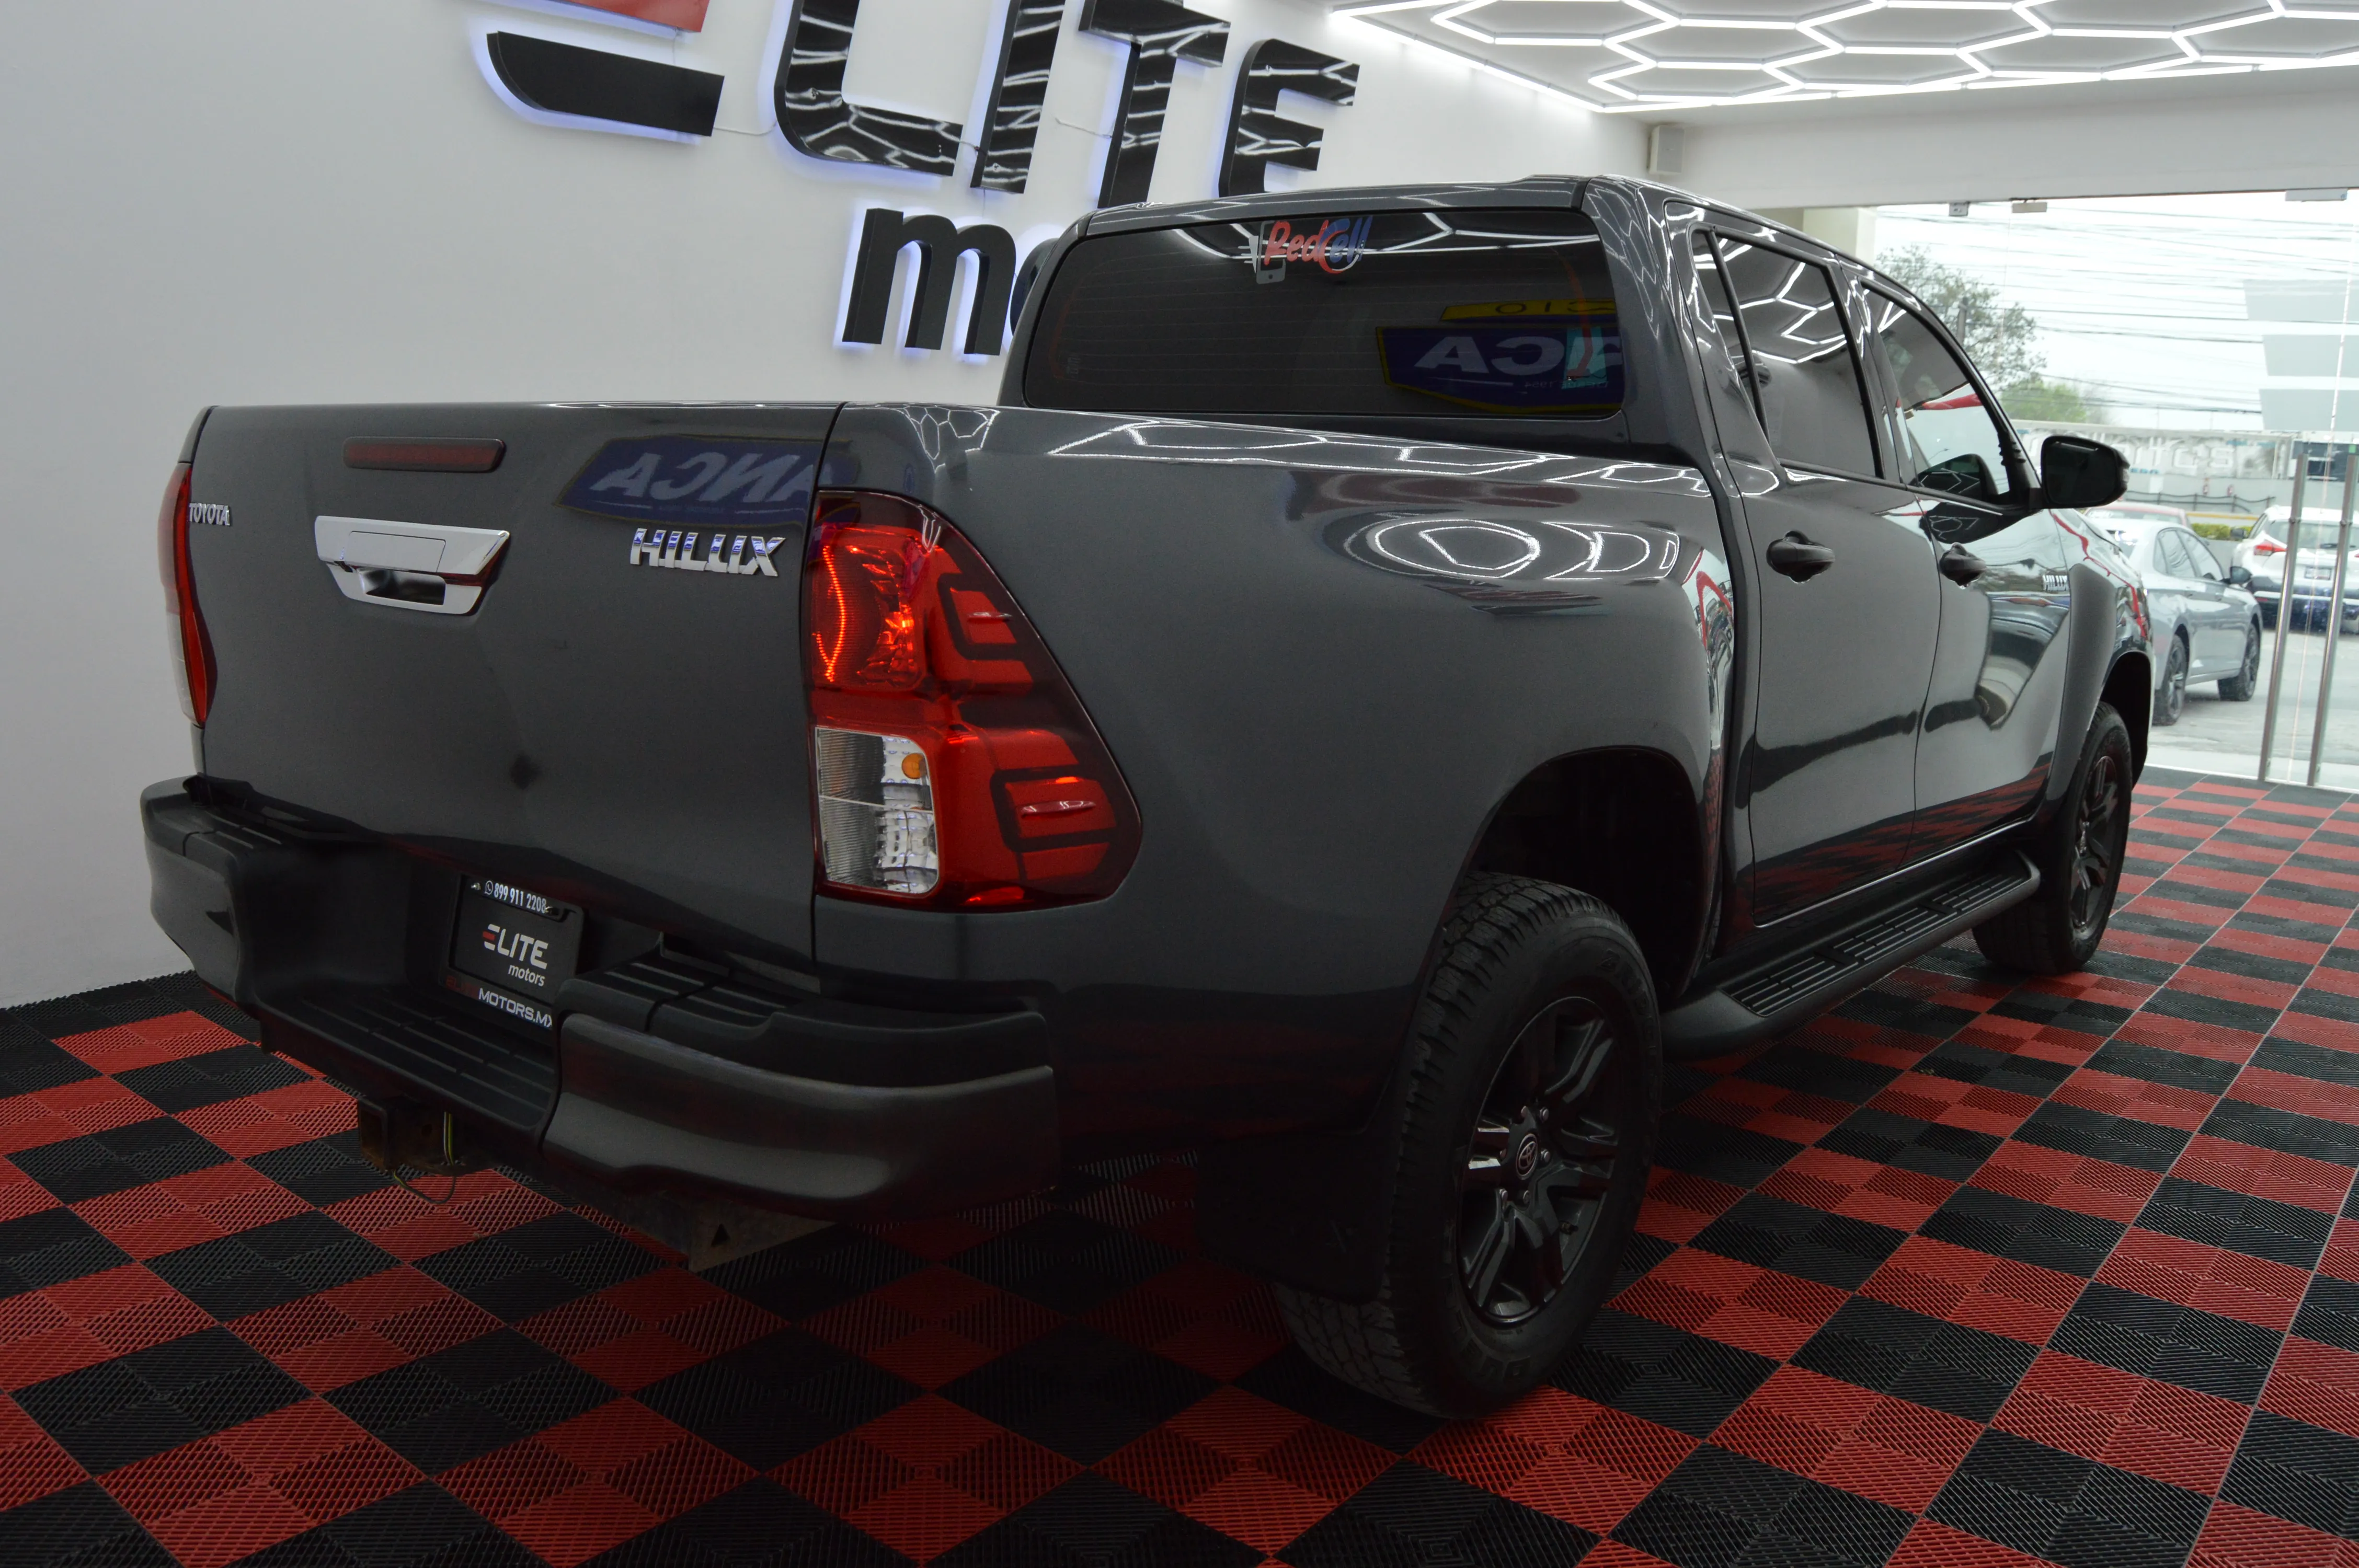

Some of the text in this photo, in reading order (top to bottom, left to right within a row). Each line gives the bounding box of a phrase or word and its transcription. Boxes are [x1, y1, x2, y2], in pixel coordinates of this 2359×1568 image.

[842, 207, 1060, 356] m
[189, 503, 230, 526] TOYOTA
[630, 528, 786, 577] HILUX
[494, 882, 547, 914] 899 911 2208
[482, 924, 549, 970] ELITE
[508, 964, 546, 987] motors
